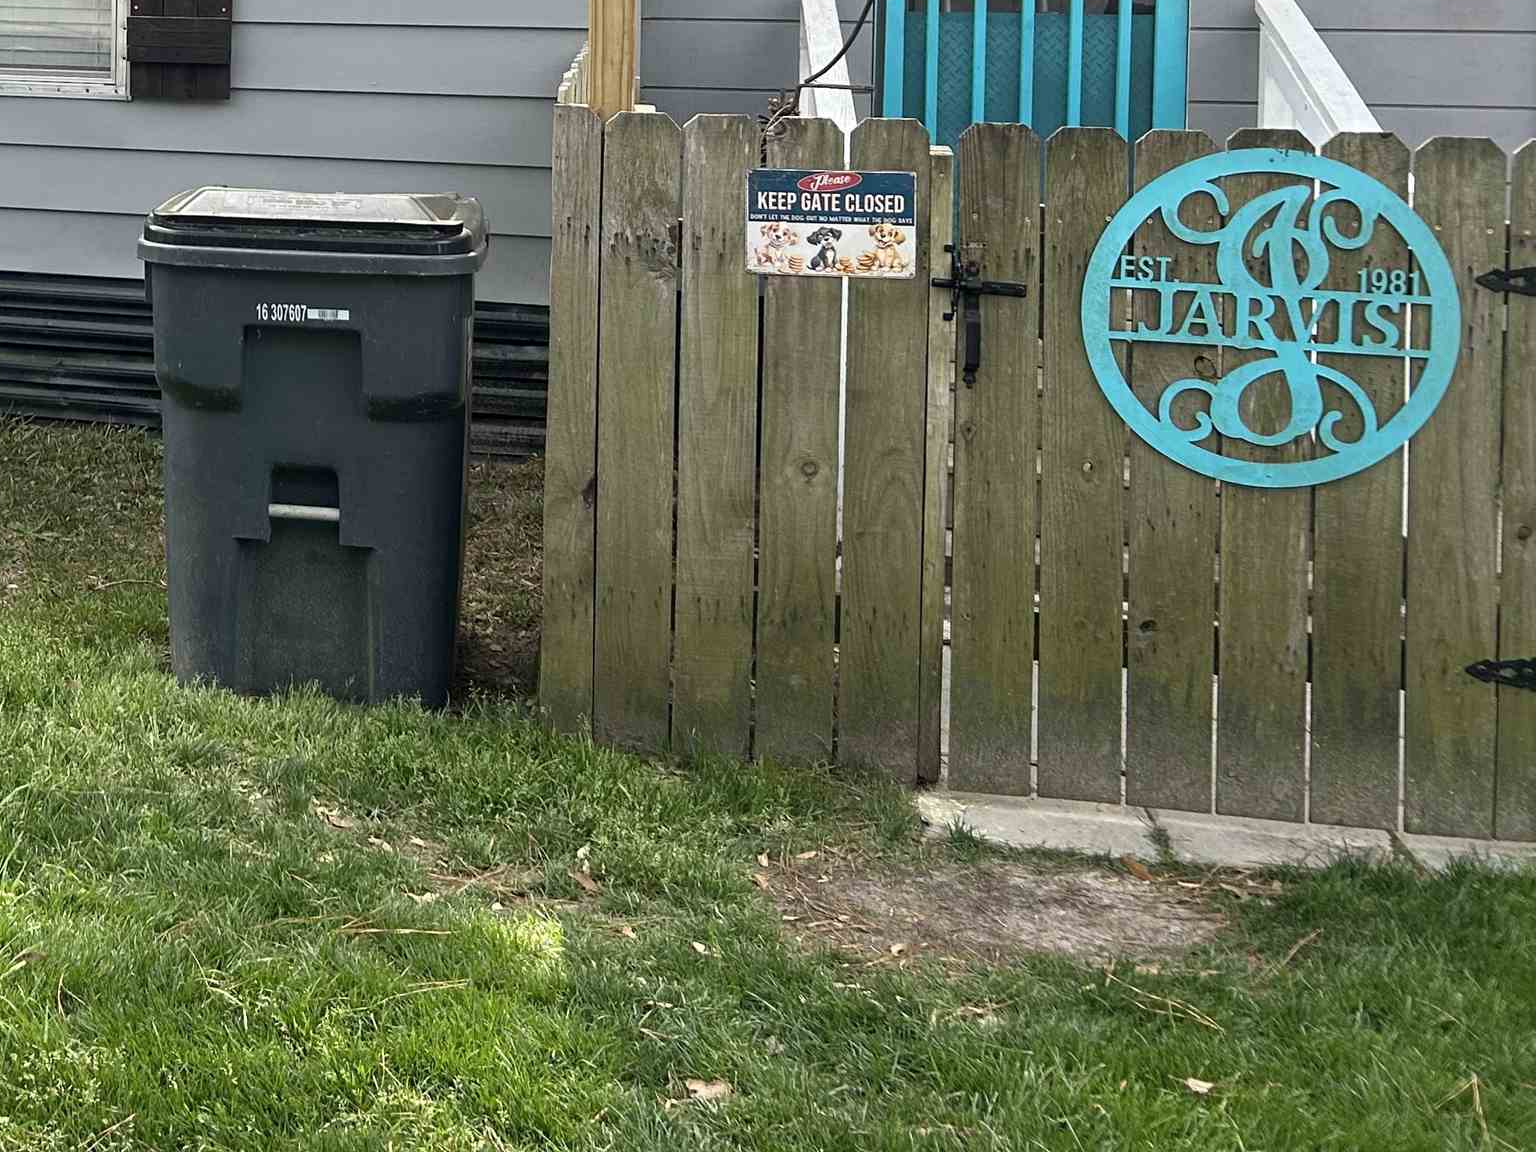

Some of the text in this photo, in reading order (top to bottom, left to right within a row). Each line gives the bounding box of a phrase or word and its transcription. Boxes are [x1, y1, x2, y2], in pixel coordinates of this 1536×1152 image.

[810, 174, 852, 191] Please
[757, 191, 905, 214] KEEP GATE CLOSED
[768, 213, 778, 221] LET
[791, 214, 805, 222] DOG
[829, 215, 852, 223] MATTER
[1120, 254, 1180, 284] EST.
[1357, 267, 1421, 297] 1981
[256, 302, 307, 322] 16 307607
[1136, 286, 1401, 349] JARVIS
